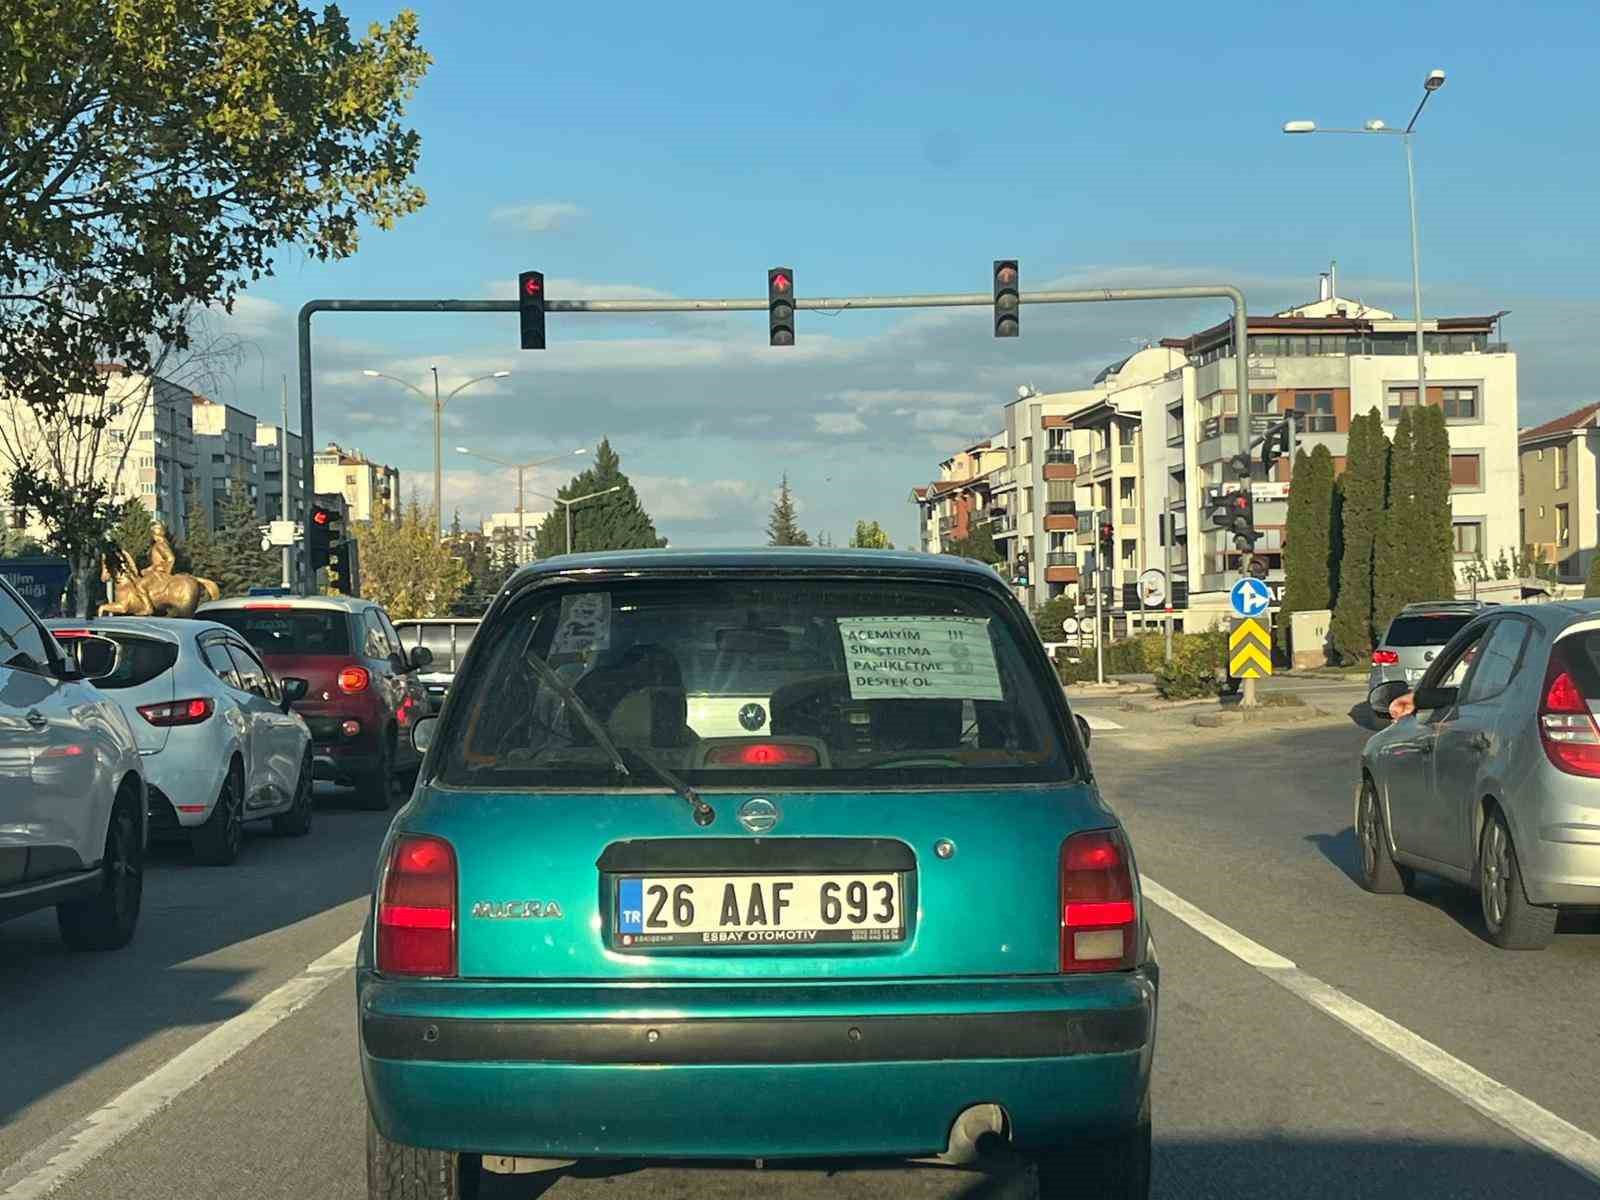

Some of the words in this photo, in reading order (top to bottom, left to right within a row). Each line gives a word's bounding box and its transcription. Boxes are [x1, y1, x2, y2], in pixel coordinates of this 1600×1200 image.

[856, 676, 908, 688] DESTEK
[912, 677, 932, 688] OL
[472, 900, 563, 919] MICRA
[623, 910, 642, 924] TR
[646, 884, 695, 928] 26
[719, 882, 794, 927] AAF
[820, 880, 895, 925] 693
